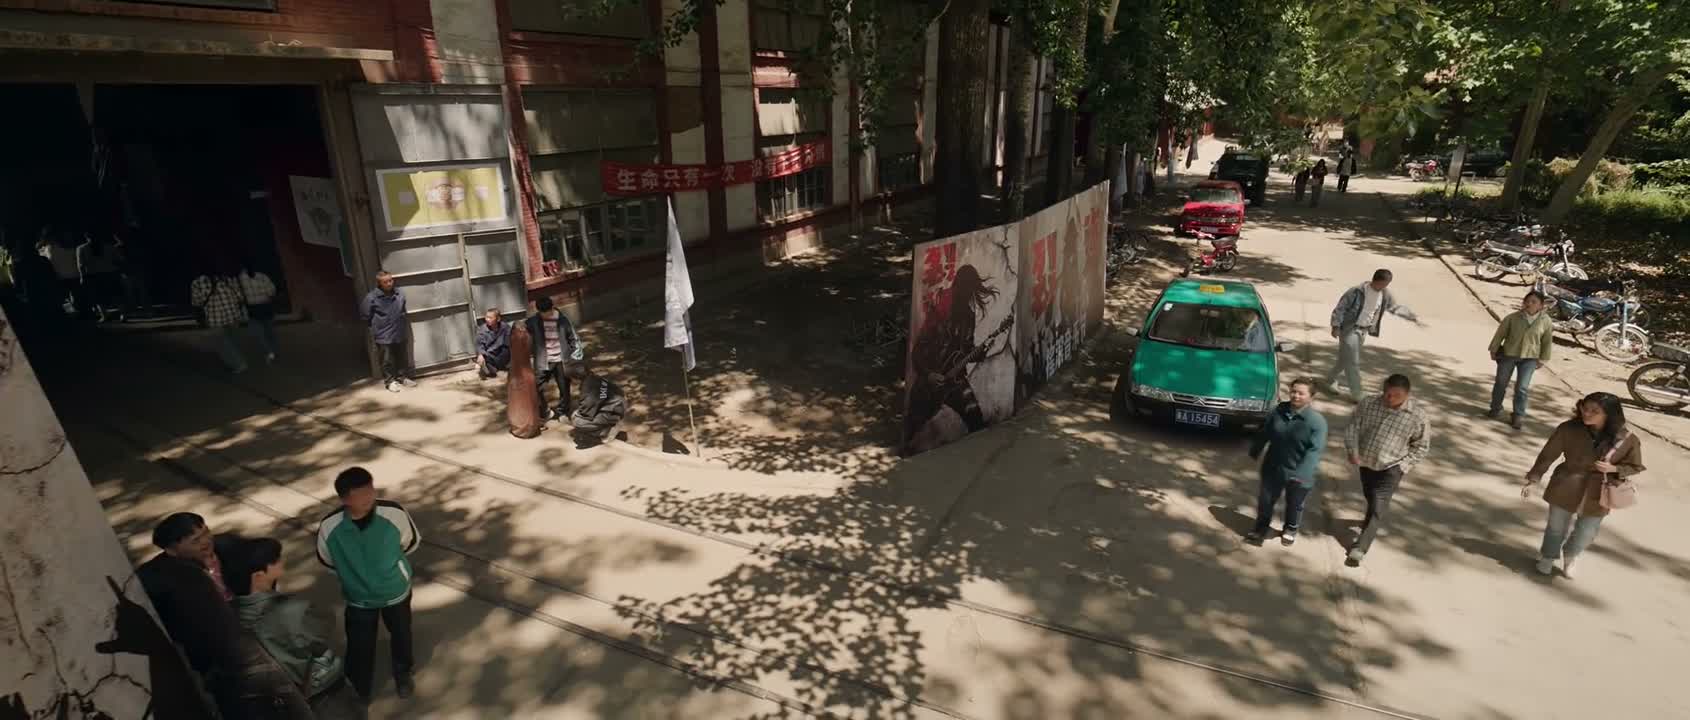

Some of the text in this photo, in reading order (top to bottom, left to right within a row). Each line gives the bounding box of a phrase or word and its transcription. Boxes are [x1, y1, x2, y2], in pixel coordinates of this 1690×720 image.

[616, 164, 736, 191] 生命只有一次
